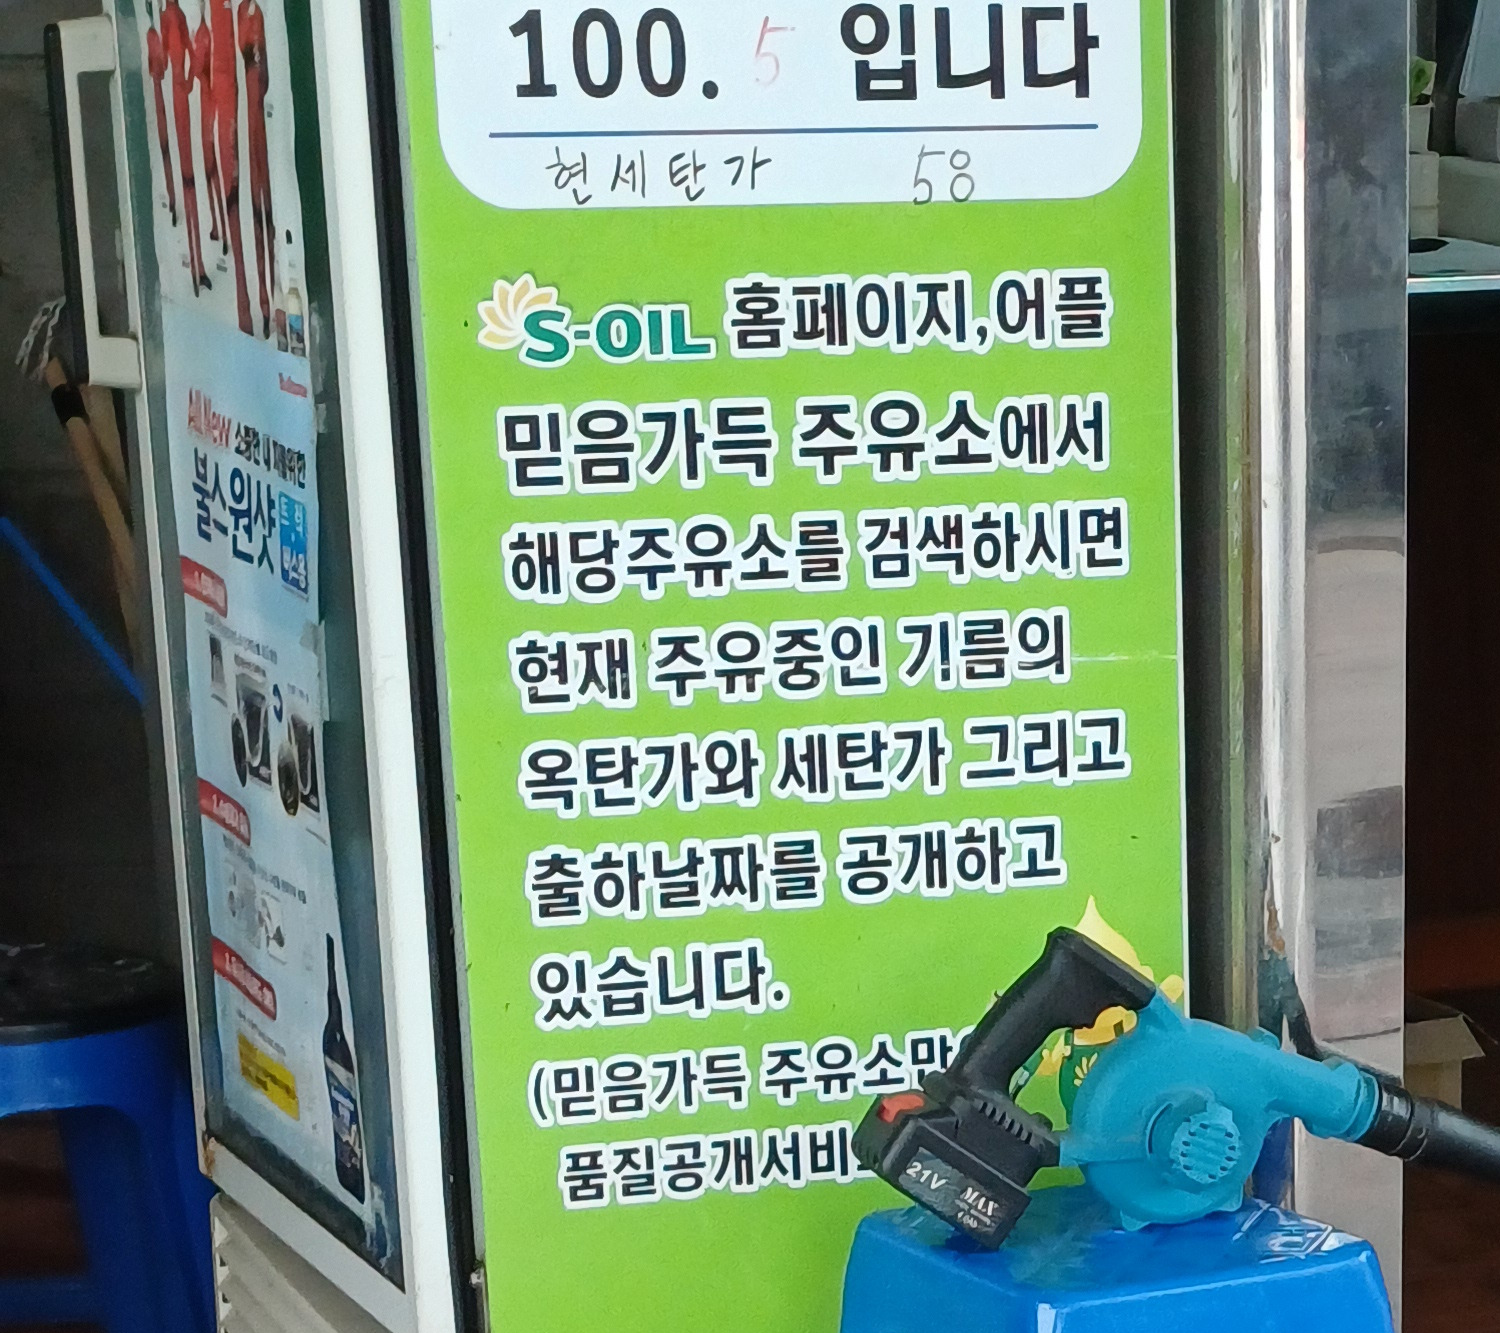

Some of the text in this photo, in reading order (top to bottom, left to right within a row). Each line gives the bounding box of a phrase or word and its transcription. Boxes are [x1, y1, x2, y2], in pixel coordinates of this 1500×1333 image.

[509, 8, 718, 99] 100.
[840, 2, 1100, 101] 입니다
[912, 145, 977, 205] 58
[523, 309, 712, 363] S-OIL
[504, 399, 1104, 487] 믿음가득 주유소에서
[192, 446, 276, 575] 불스원샷
[508, 506, 1123, 595] 해당주유소를 검색하시면
[515, 614, 1065, 704] 현재 주유중인 기름의
[525, 717, 1125, 810] 옥탄가와 세탄가 그리고
[531, 824, 1061, 918] 출하날짜를 공개하고
[537, 946, 784, 1023] 있습니다.
[532, 1034, 974, 1120] (믿음가득 주유소만
[563, 1127, 870, 1202] 품질공개서비
[905, 1162, 949, 1190] 21V
